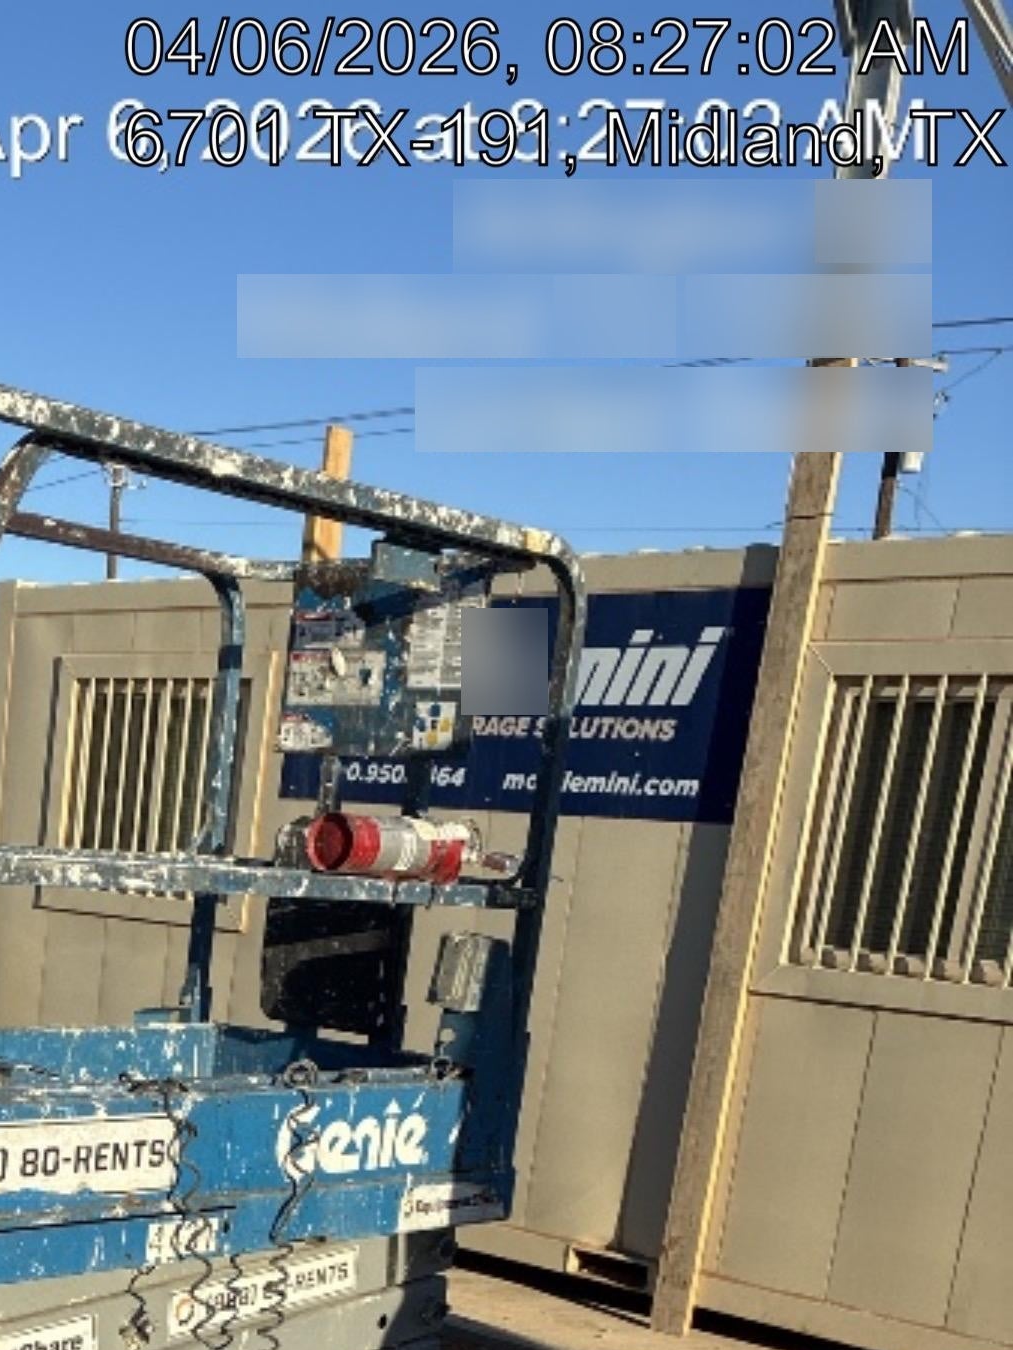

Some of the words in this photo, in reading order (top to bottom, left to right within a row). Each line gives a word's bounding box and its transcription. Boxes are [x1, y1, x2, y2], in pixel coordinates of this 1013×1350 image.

[532, 717, 677, 741] SLUTIONS
[502, 769, 701, 797] molemini.com
[276, 1096, 429, 1182] Genie
[20, 1139, 166, 1177] 80-RENTS
